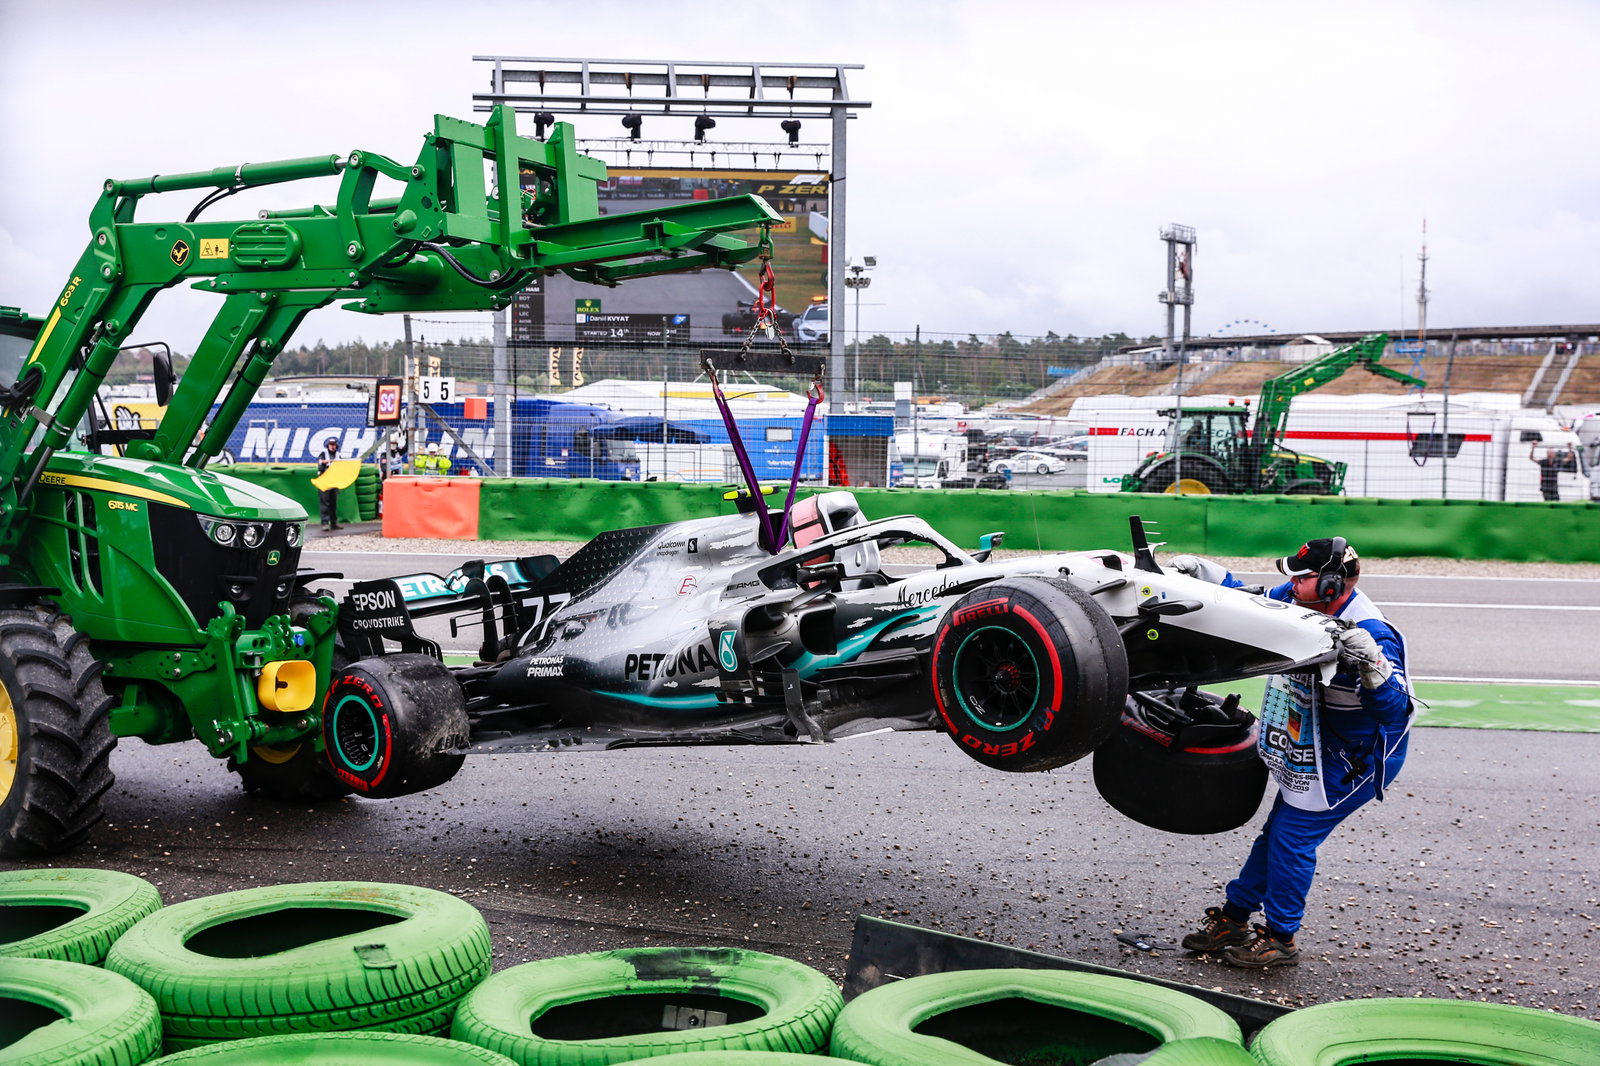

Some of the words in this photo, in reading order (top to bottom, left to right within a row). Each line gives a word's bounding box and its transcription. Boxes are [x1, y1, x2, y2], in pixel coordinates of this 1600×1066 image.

[758, 185, 776, 194] P
[60, 284, 76, 307] 603
[72, 276, 82, 286] R
[423, 381, 430, 400] 5
[440, 382, 449, 401] 5
[379, 393, 395, 412] SC
[1120, 427, 1154, 436] FACH
[40, 474, 66, 484] DEERE
[125, 502, 139, 512] MC
[657, 541, 686, 550] Qualcomm
[679, 577, 693, 594] E
[736, 580, 760, 589] AMG
[352, 590, 396, 612] EPSON
[517, 592, 571, 647] 77
[953, 597, 1009, 627] PIRELLI
[529, 655, 564, 665] PETRONAS
[526, 666, 564, 677] PRIMAX
[343, 675, 384, 708] ZERO
[961, 731, 1037, 757] ZERO
